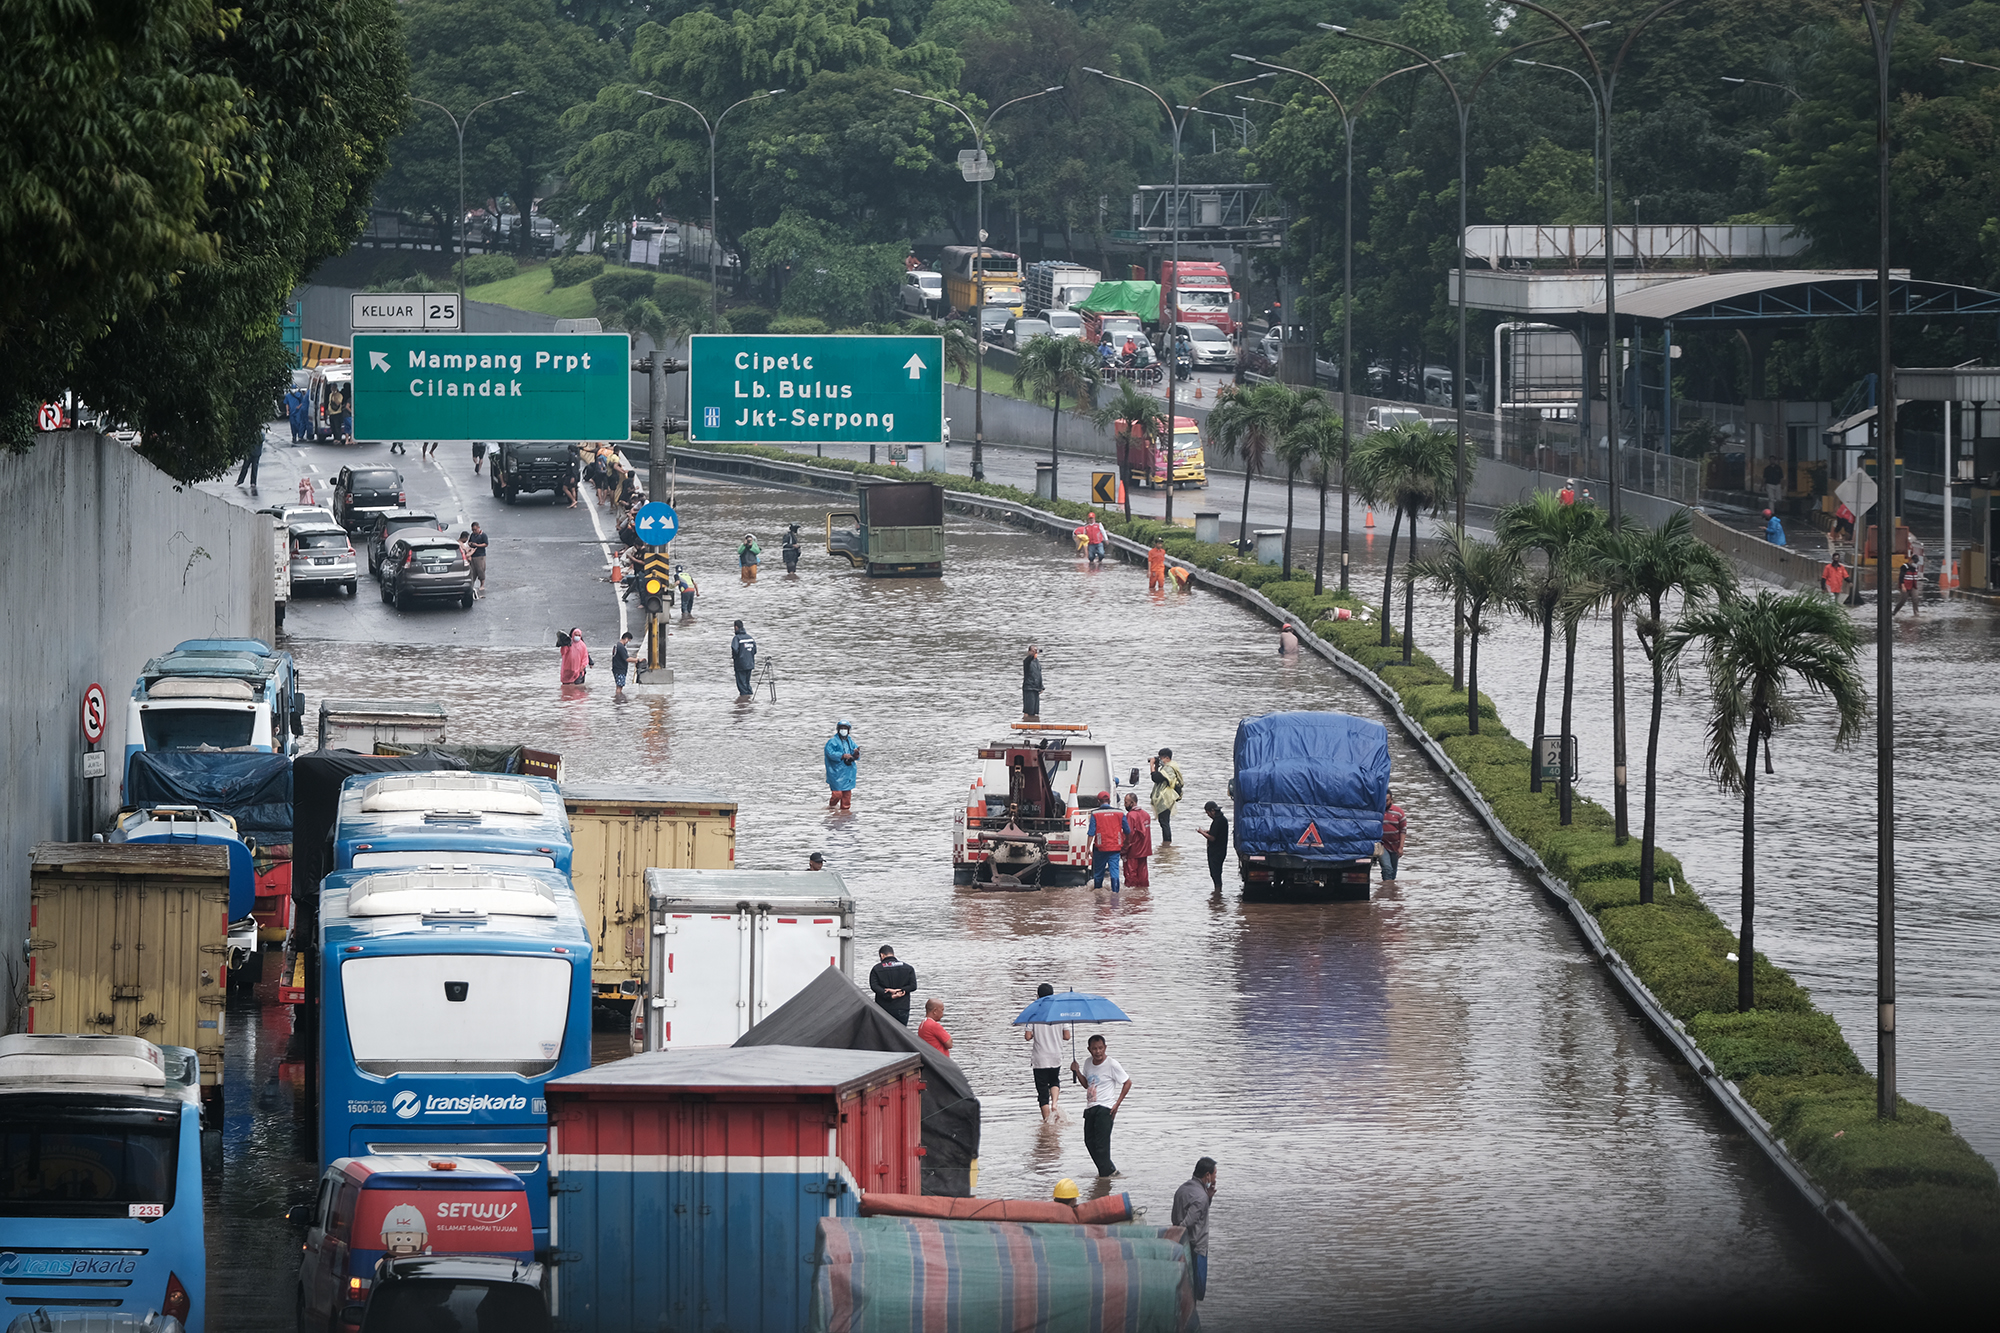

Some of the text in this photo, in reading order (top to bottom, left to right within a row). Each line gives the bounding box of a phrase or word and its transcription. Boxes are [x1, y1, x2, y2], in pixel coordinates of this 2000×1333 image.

[362, 305, 455, 319] KELUAR 25
[408, 350, 592, 374] Mampang Prpt
[409, 378, 522, 397] Cilandak
[734, 380, 853, 398] Lb. Bulus
[734, 408, 895, 433] Jkt-Serpong
[347, 1104, 388, 1114] 1500-102
[424, 1094, 527, 1115] transjakarta
[139, 1205, 161, 1216] 235
[437, 1202, 513, 1220] SETUJU
[436, 1224, 467, 1232] SELAMAT
[467, 1225, 491, 1233] SAMPAI
[23, 1256, 137, 1277] transjakarta
